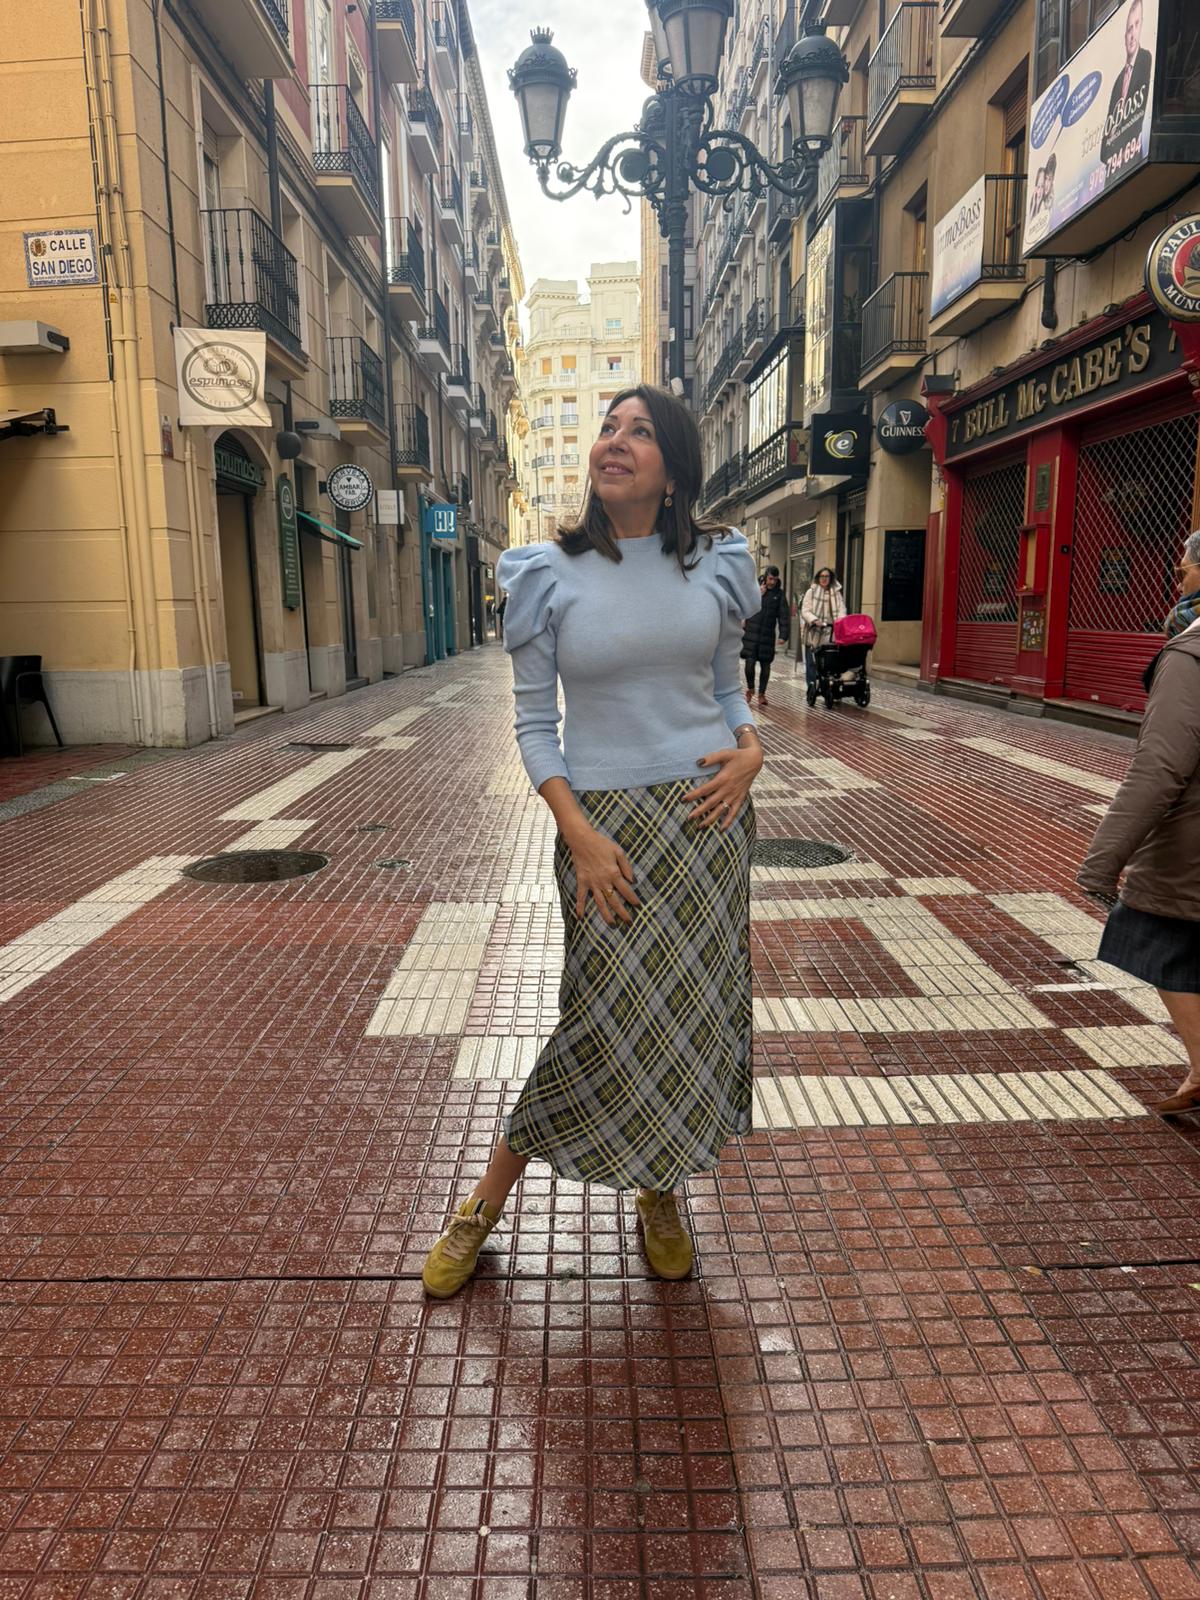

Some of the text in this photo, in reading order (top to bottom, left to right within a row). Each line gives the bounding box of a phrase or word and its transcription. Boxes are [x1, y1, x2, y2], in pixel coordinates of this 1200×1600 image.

[1106, 152, 1122, 178] 794
[1124, 134, 1142, 163] 694
[50, 238, 86, 251] CALLE
[32, 258, 93, 275] SAN DIEGO
[963, 393, 1010, 443] BULL
